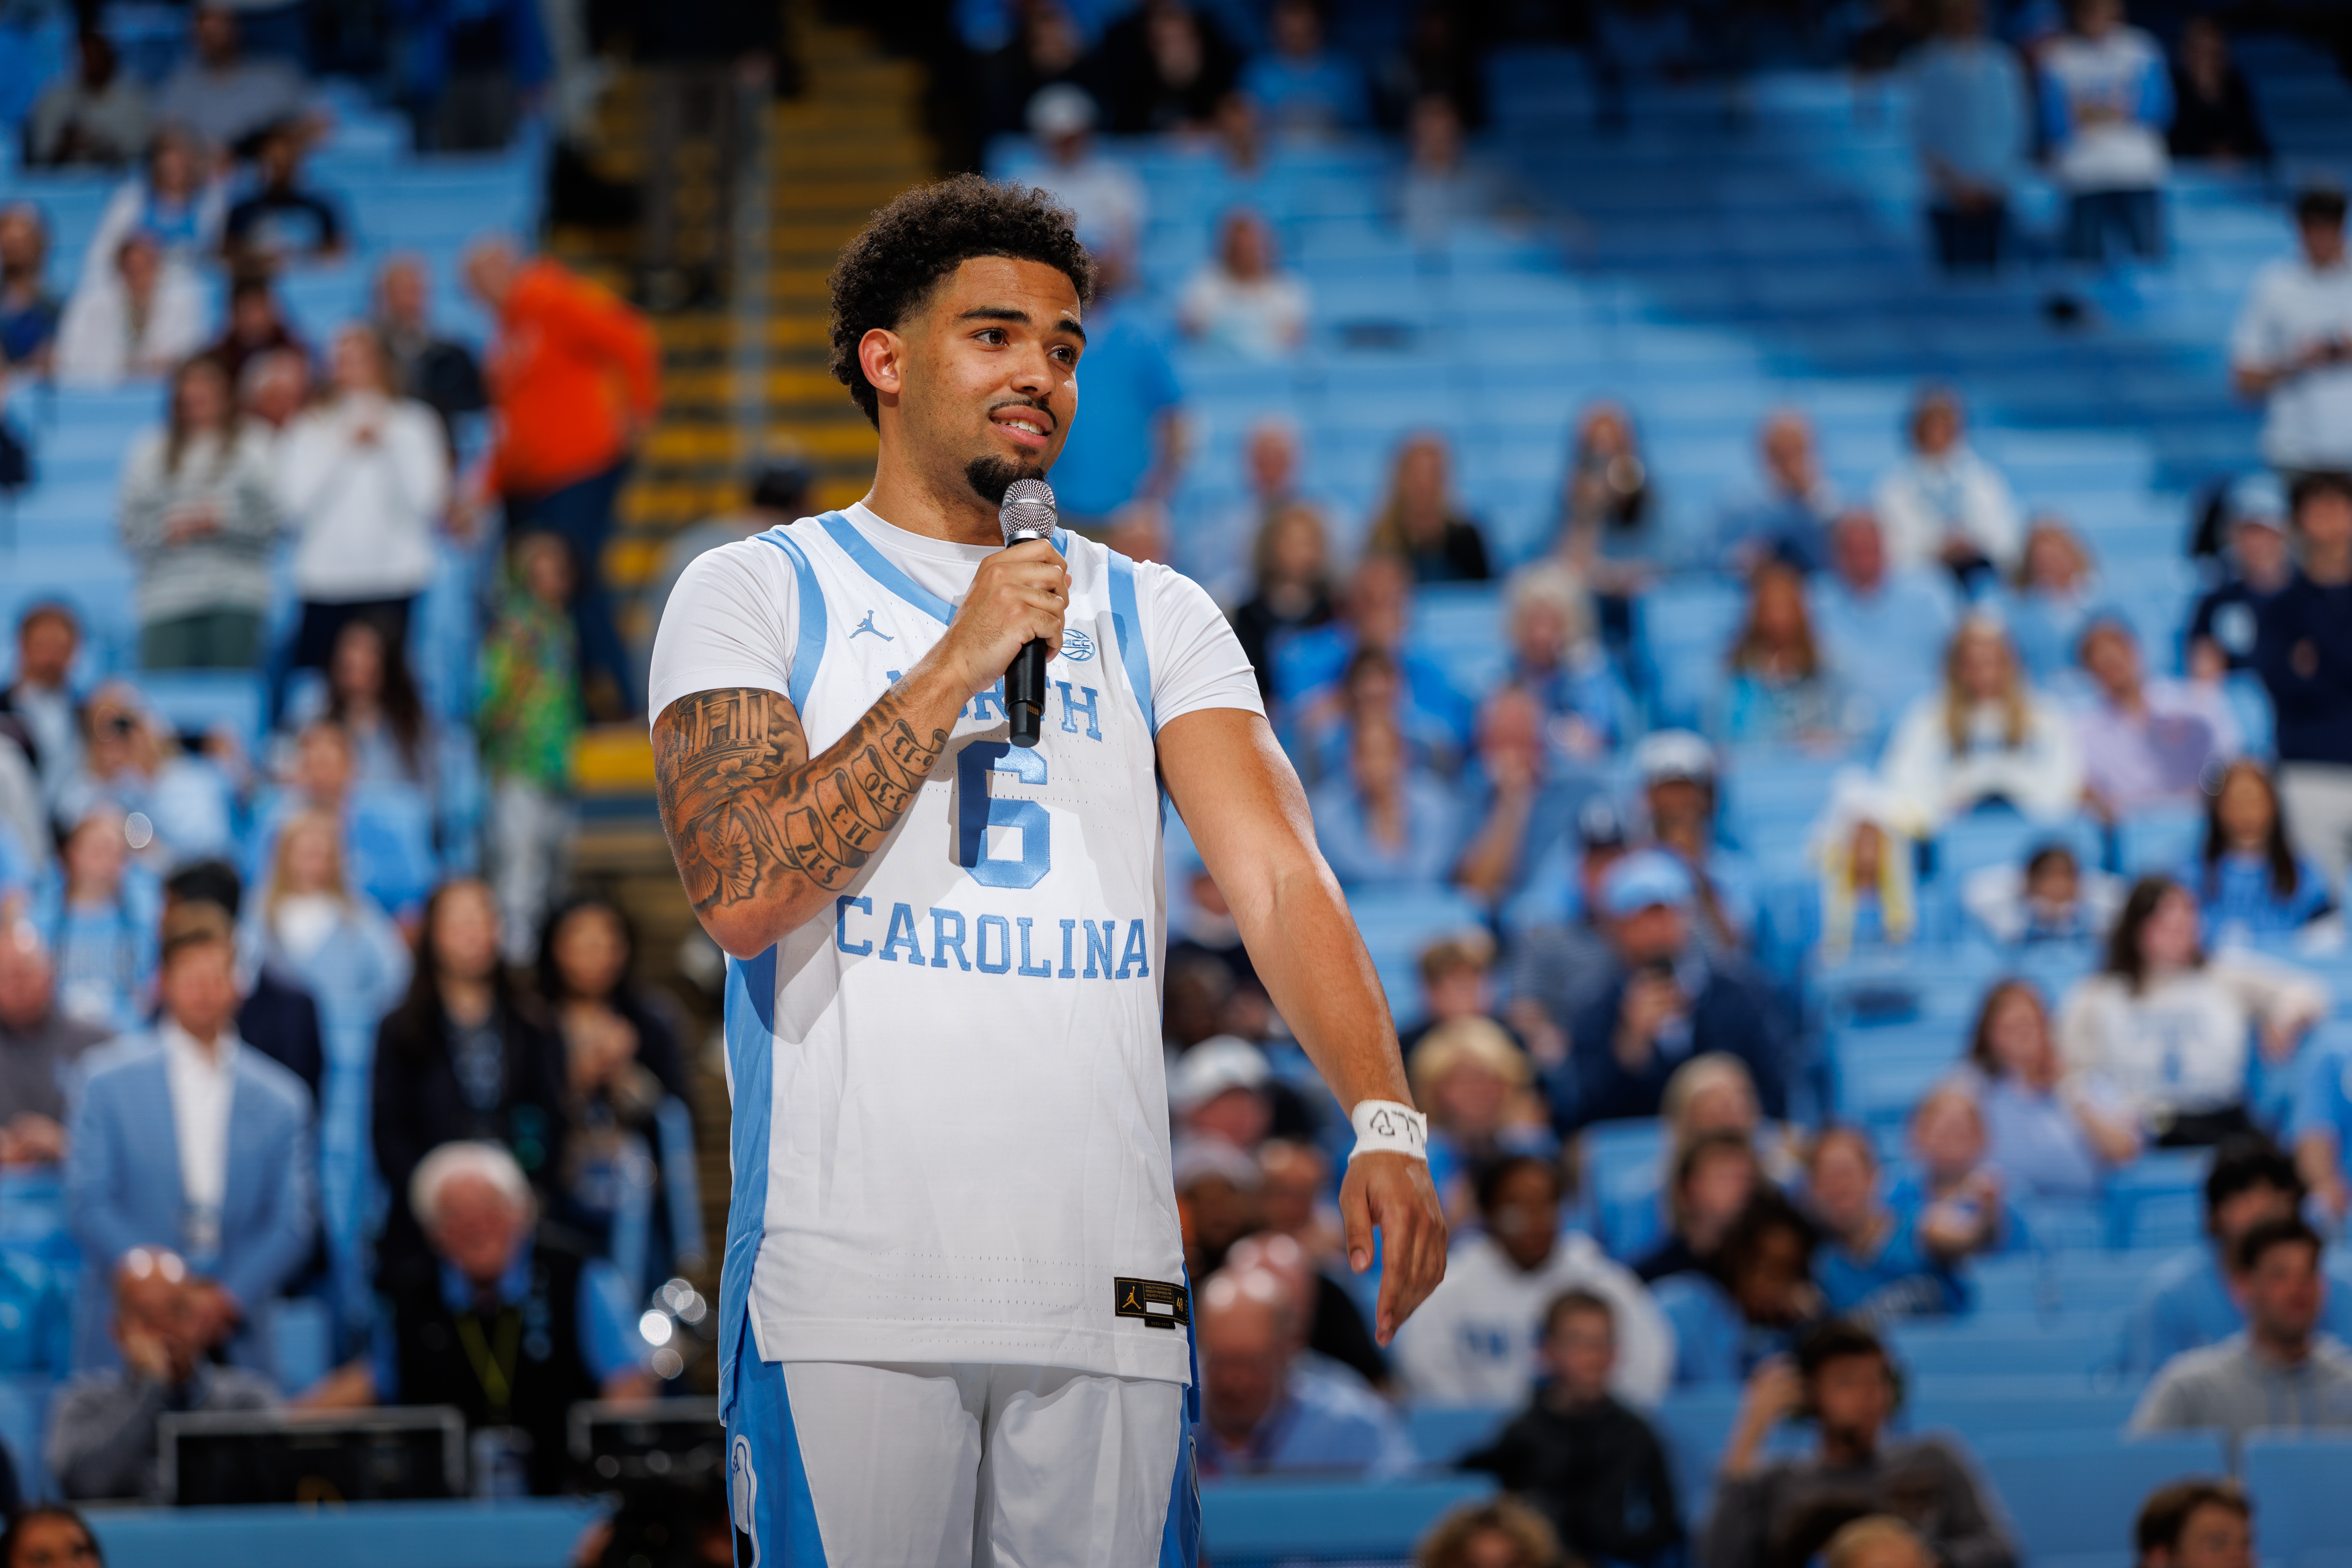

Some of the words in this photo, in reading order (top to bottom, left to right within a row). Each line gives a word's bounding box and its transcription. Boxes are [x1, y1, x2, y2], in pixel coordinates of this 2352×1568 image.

[893, 736, 934, 772] 6-13
[865, 773, 908, 811] 3-30
[830, 804, 871, 846] 11-3
[957, 740, 1051, 889] 6
[796, 841, 841, 884] 5-17
[836, 895, 1150, 980] CAROLINA
[1176, 1297, 1183, 1312] 48
